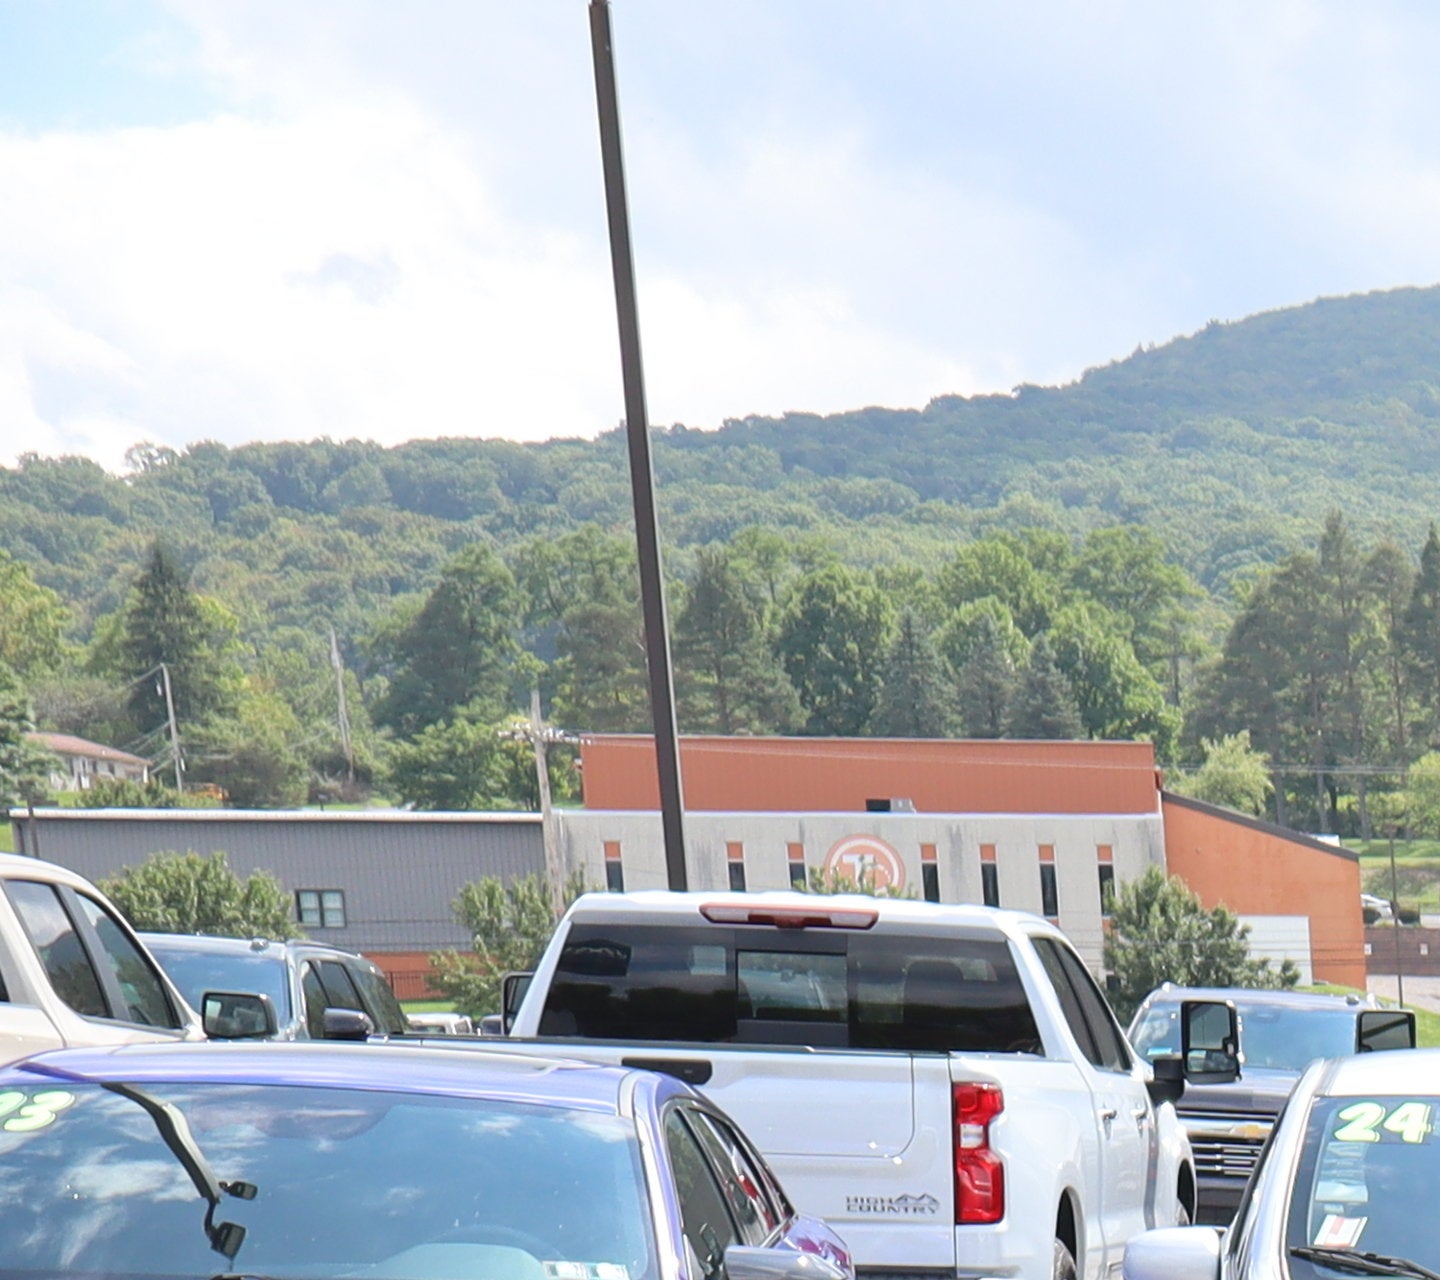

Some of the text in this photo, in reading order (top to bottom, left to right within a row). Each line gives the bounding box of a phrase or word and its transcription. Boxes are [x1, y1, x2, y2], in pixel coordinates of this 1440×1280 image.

[1334, 1101, 1432, 1143] 24
[846, 1196, 893, 1204] HIGH
[847, 1204, 938, 1214] COUNTRY
